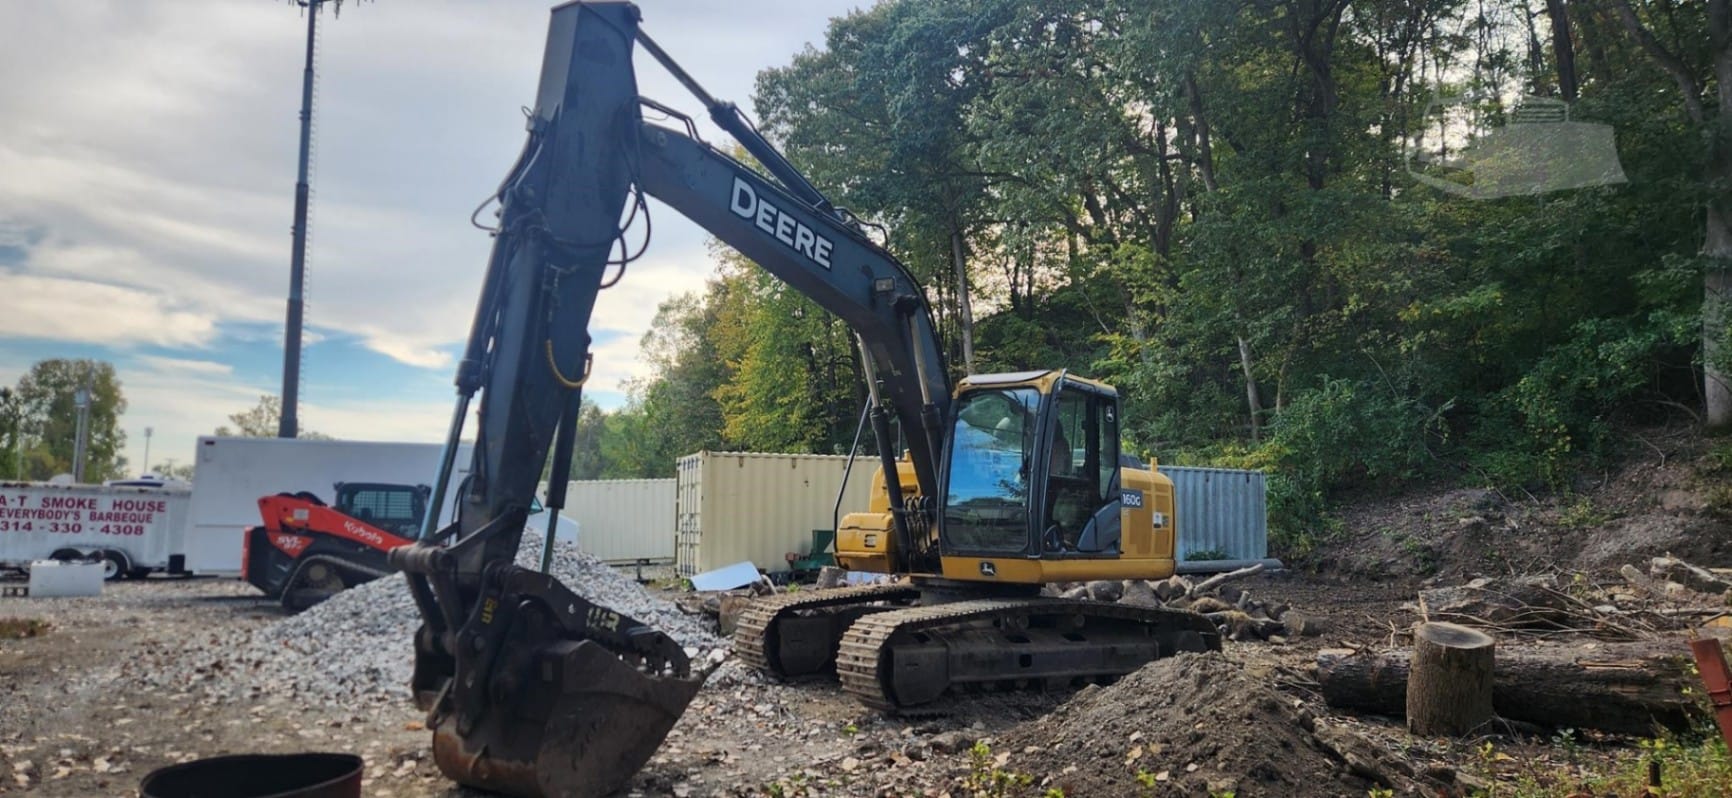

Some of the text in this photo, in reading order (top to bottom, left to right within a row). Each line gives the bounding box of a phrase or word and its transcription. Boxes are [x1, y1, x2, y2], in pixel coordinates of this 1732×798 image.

[731, 177, 833, 269] DEERE
[41, 497, 98, 510] SMOKE
[112, 499, 166, 513] HOUSE
[0, 508, 153, 524] EVERYBODY'S BARBEQUE
[0, 521, 32, 532] 314
[49, 522, 82, 534] 330
[100, 524, 144, 536] 4308
